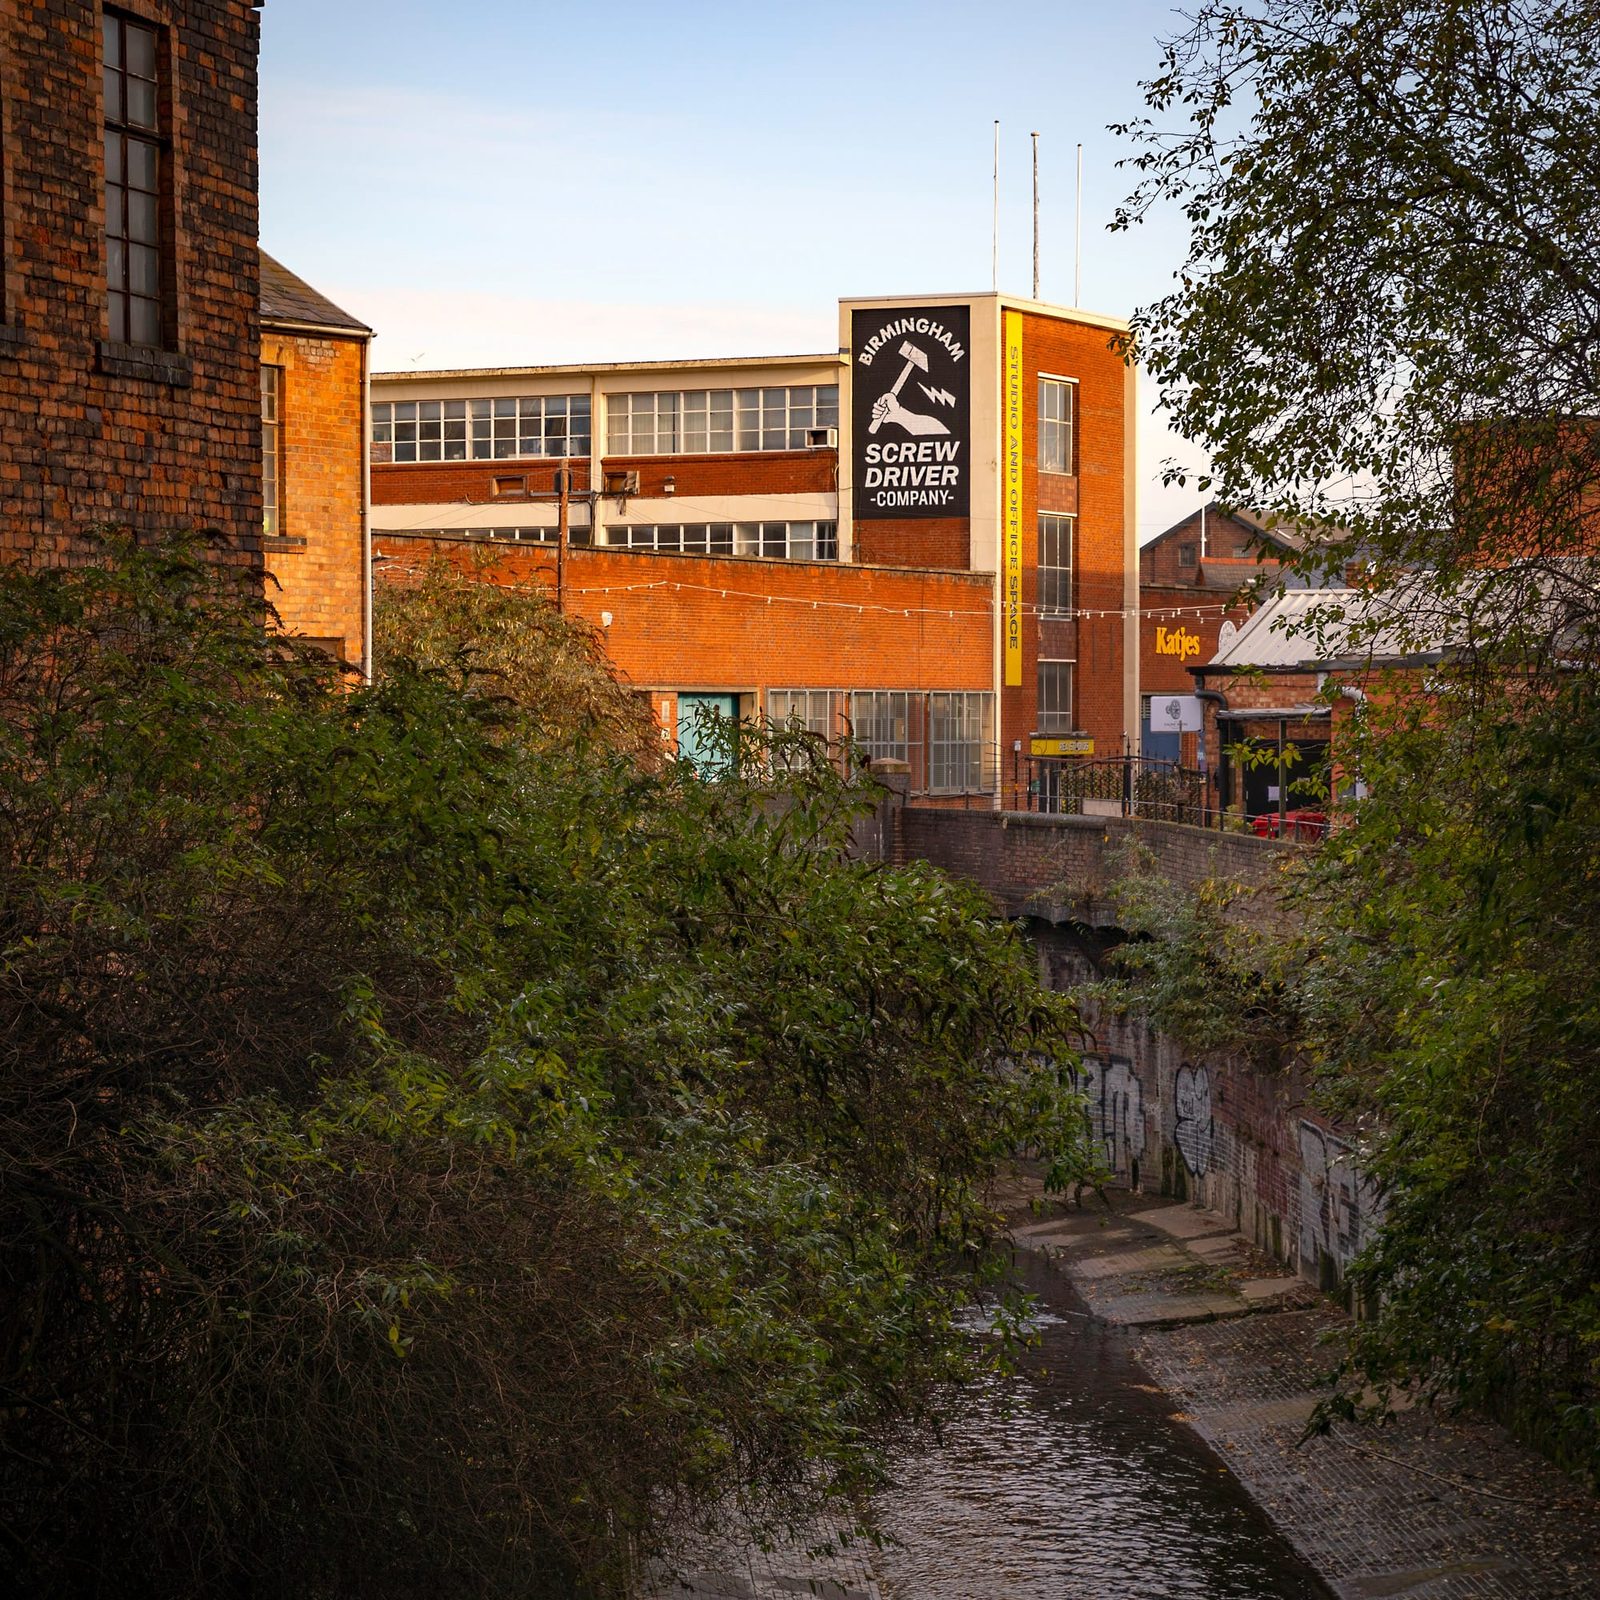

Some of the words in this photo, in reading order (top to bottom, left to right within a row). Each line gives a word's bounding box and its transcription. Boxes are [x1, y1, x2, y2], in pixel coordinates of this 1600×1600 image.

[858, 317, 965, 366] BIRMINGHAM
[1010, 346, 1019, 430] STUDIO
[864, 440, 961, 464] SCREW
[1010, 435, 1019, 484] AND
[864, 466, 960, 488] DRIVER
[1010, 489, 1019, 571] OFFICE
[1010, 575, 1019, 650] SPACE
[1155, 626, 1200, 662] Katjes
